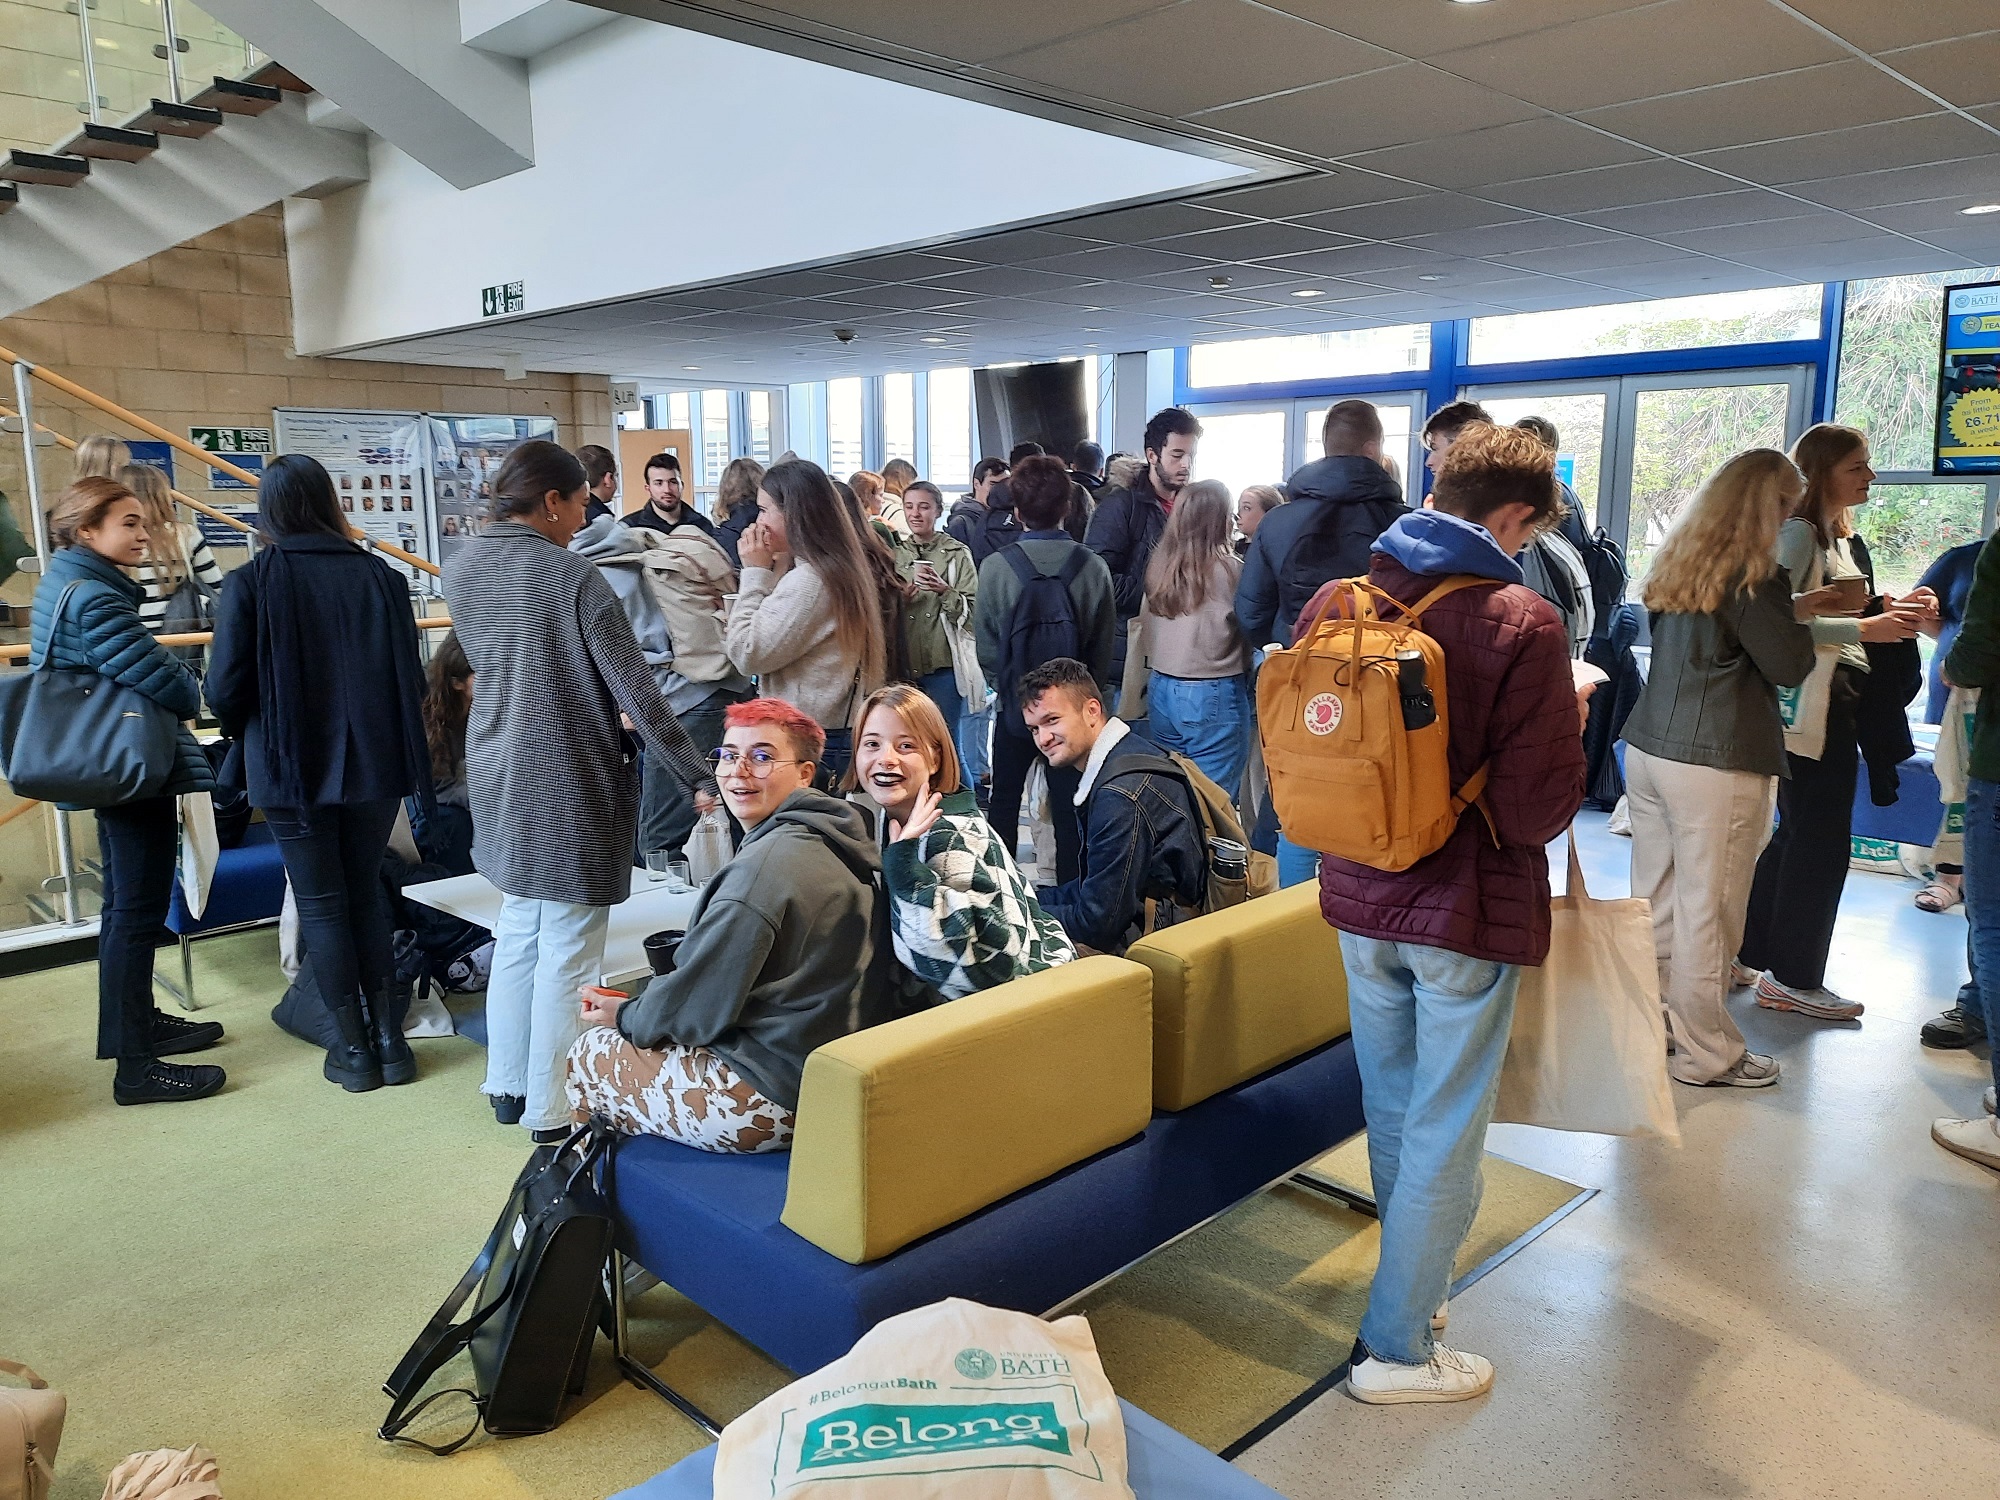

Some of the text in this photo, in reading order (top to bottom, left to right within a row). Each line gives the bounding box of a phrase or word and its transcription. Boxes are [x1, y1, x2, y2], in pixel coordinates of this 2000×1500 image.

[507, 281, 522, 297] FIRE
[508, 297, 523, 312] EXIT
[1971, 295, 1998, 306] BATH
[1970, 398, 1991, 407] From
[1973, 406, 1990, 414] little
[1965, 412, 2000, 428] £6.71
[241, 430, 269, 440] FIRE
[1978, 424, 1998, 433] week
[242, 441, 269, 452] EXIT
[1001, 1358, 1070, 1376] BATH
[809, 1377, 937, 1406] #BelongatBath
[818, 1413, 1044, 1452] Belong
